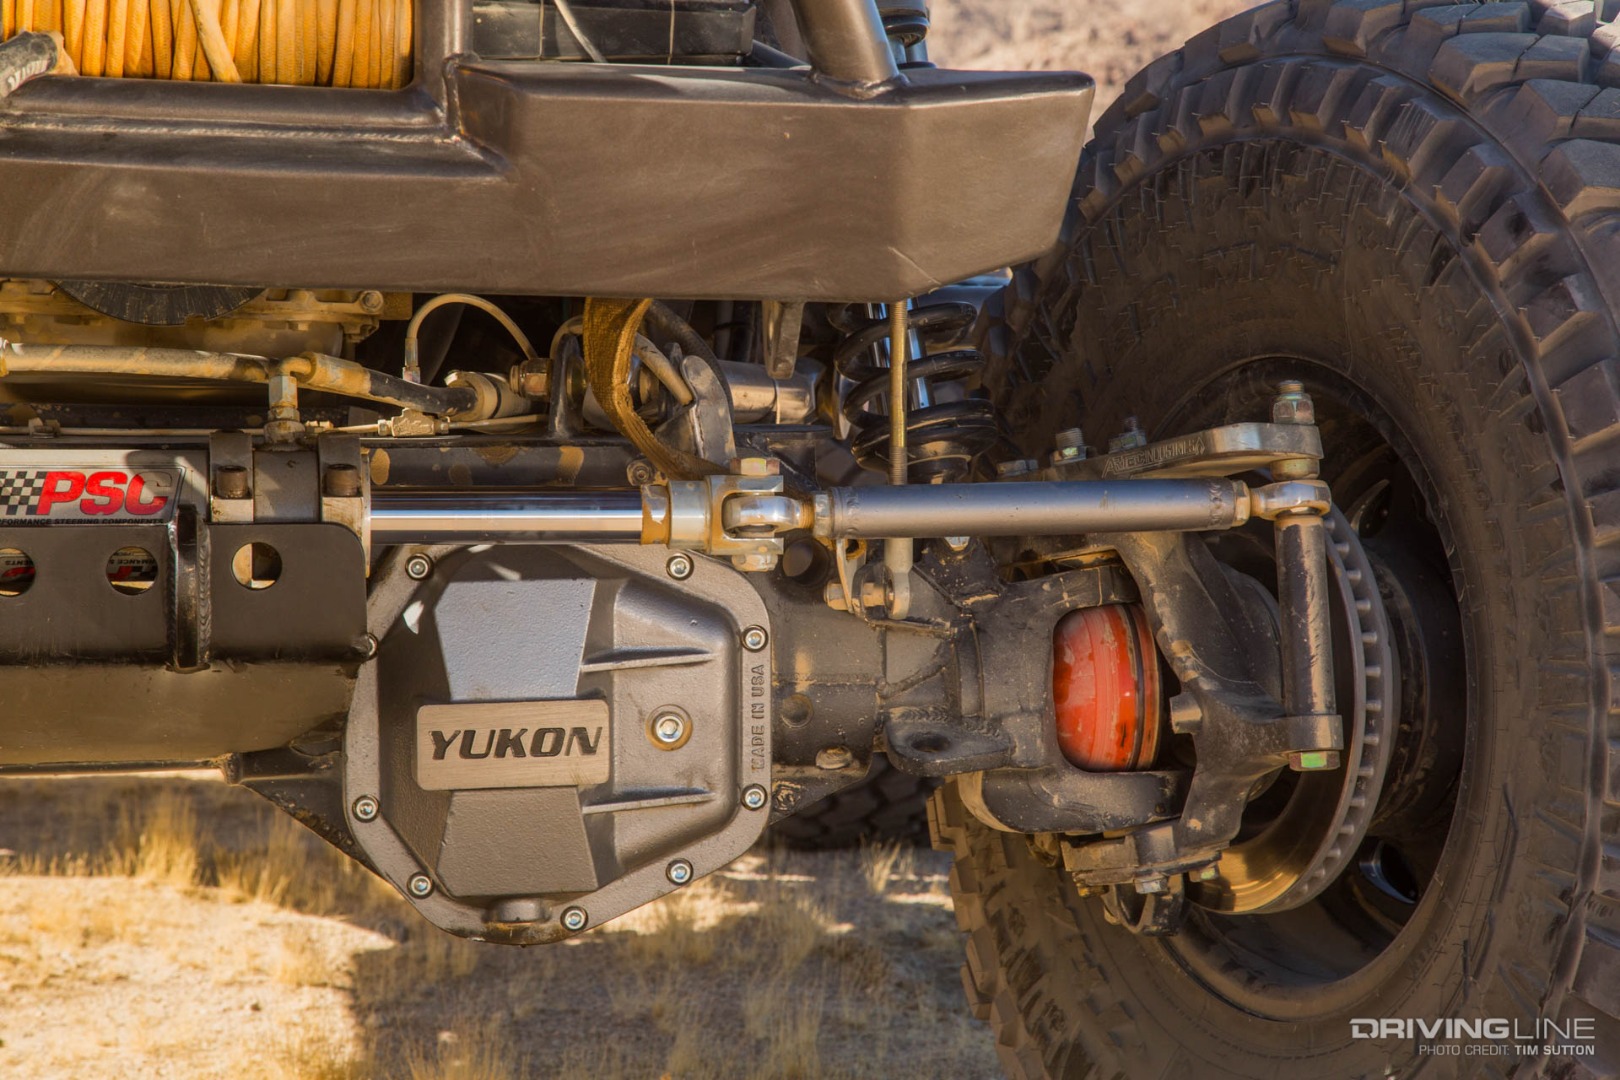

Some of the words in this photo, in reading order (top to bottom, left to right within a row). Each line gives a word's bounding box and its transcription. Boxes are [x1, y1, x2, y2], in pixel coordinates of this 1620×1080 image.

[36, 470, 172, 515] PSC
[0, 518, 52, 527] FORMANCE
[750, 664, 765, 697] USA
[750, 703, 765, 719] IN
[429, 726, 603, 760] YUKON
[750, 725, 765, 771] MADE
